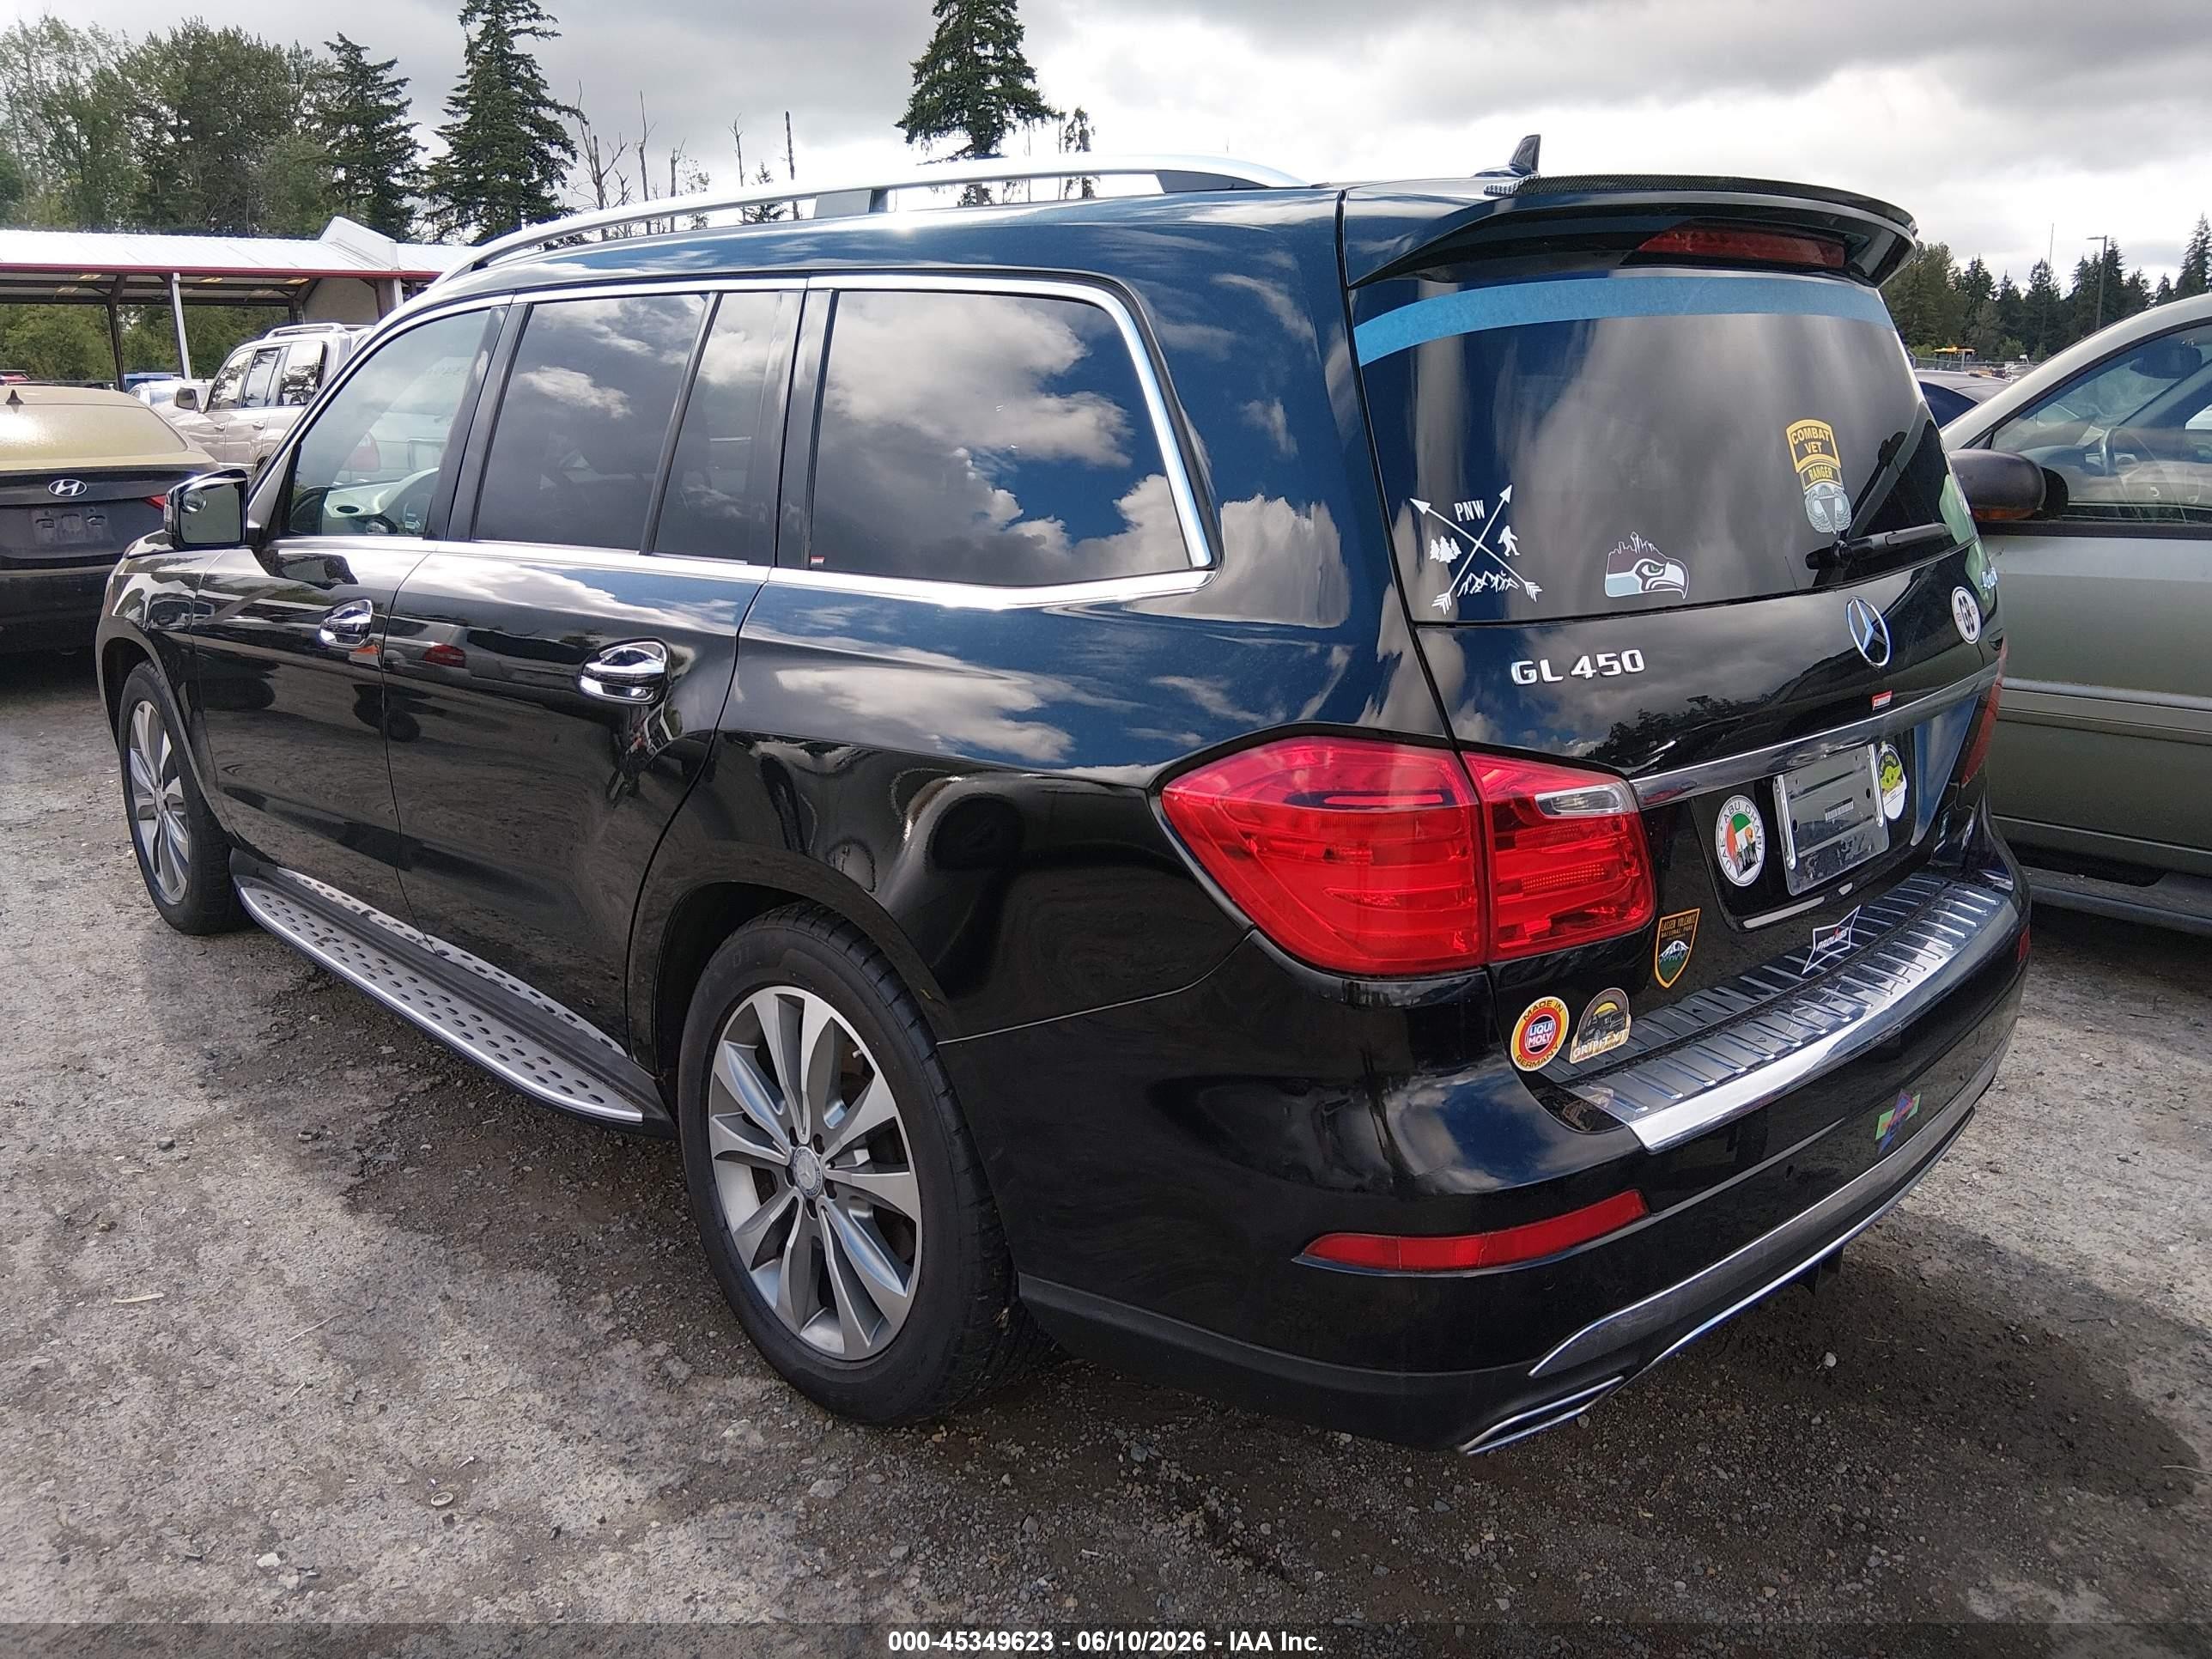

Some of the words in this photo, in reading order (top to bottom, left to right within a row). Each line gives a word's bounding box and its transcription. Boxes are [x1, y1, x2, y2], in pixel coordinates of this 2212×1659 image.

[1790, 427, 1830, 445] COMBAT
[1804, 441, 1822, 454] VET
[1808, 465, 1833, 482] RANGER
[1454, 500, 1485, 522] PNW
[1510, 659, 1564, 686] GL
[1571, 648, 1645, 680] 450
[1723, 801, 1741, 824] ABU
[1744, 804, 1763, 851] DHABI
[1522, 1000, 1554, 1022] MADE
[1554, 1000, 1564, 1013] IN
[1528, 1021, 1554, 1037] LIQUI
[1527, 1032, 1553, 1047] MOLY
[1516, 1043, 1559, 1068] GERMANY
